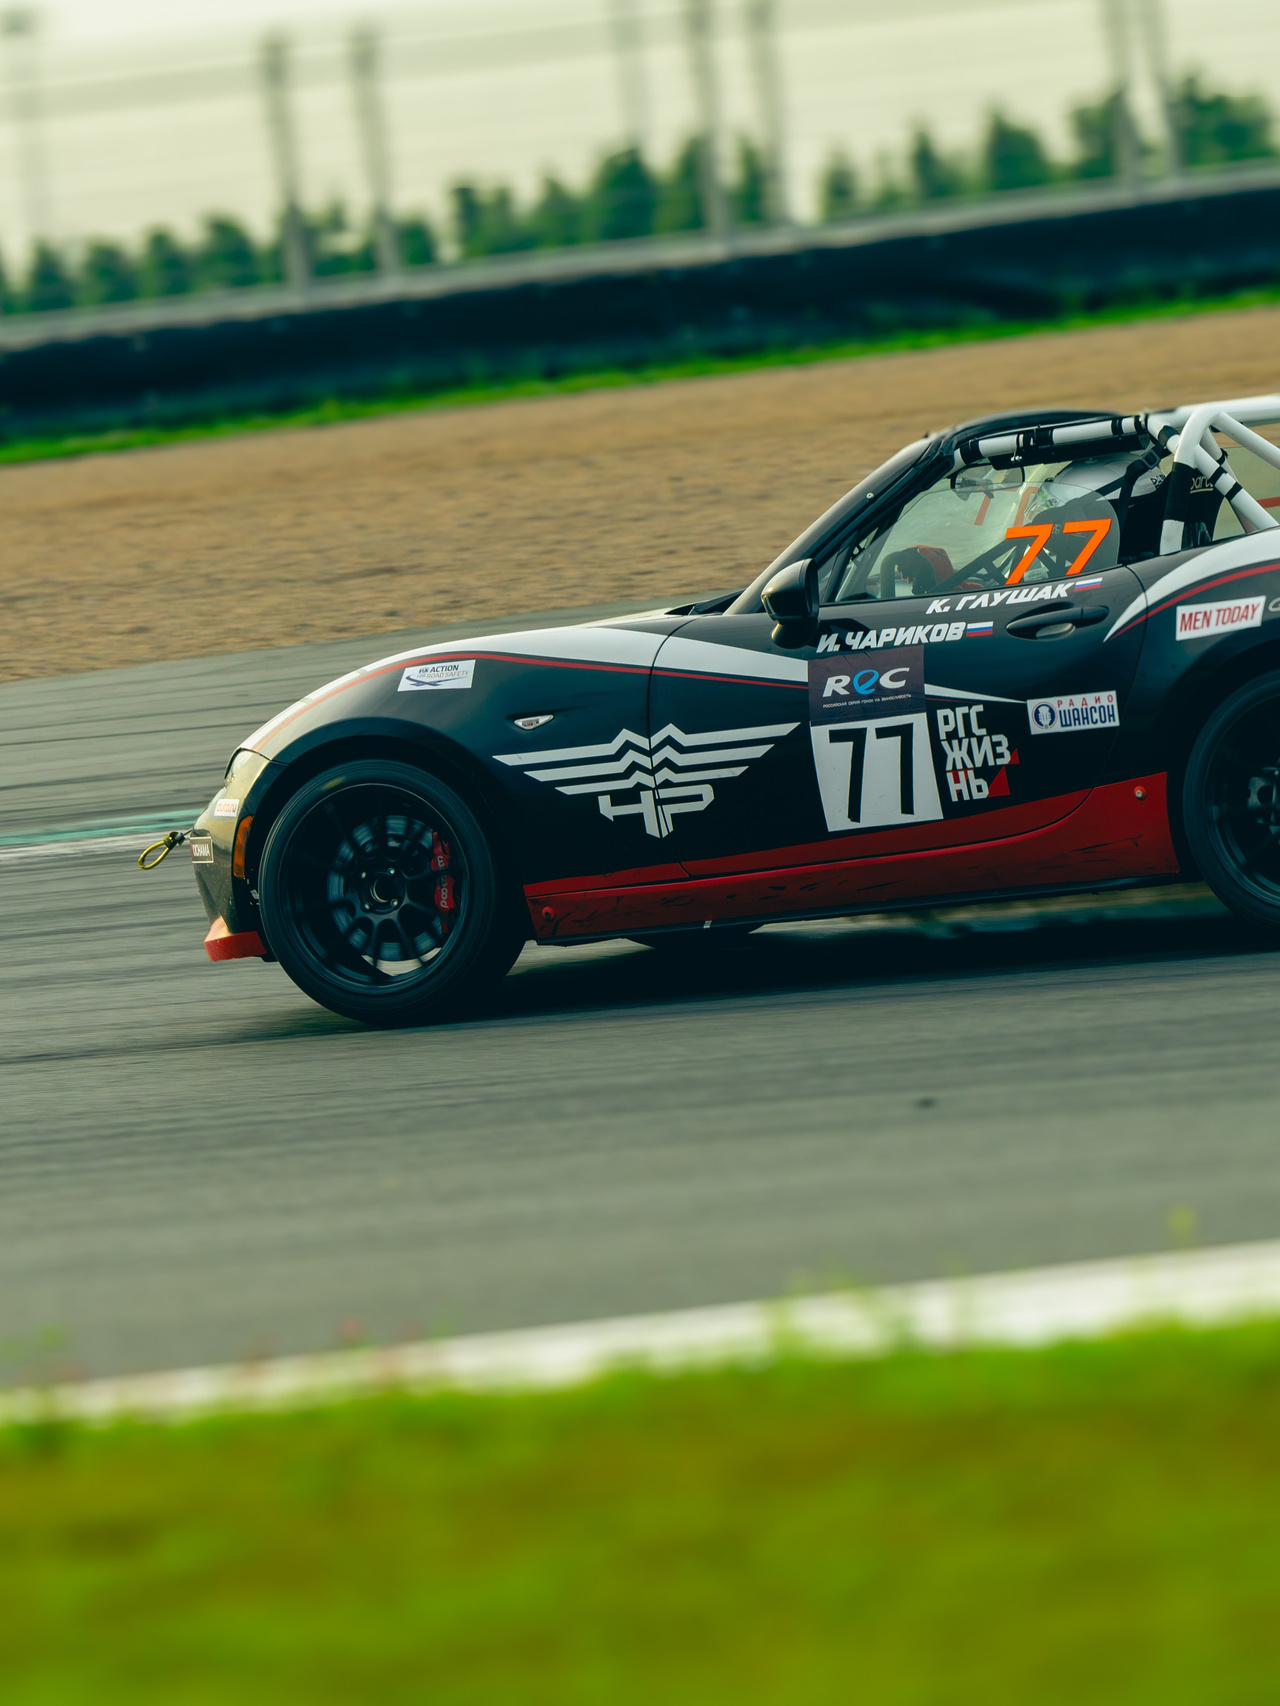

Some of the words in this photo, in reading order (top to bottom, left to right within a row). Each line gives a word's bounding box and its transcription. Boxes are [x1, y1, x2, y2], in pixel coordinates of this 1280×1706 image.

[1005, 518, 1112, 585] 77
[955, 583, 1075, 611] ГЛУШАК
[1179, 609, 1211, 632] MEN
[1214, 603, 1260, 627] TODAY
[845, 621, 967, 649] ЧАРИКОВ
[430, 664, 460, 673] ACTION
[445, 670, 469, 678] SAFETY
[1057, 694, 1114, 708] РАДИО
[937, 704, 988, 740] РГС
[1059, 704, 1116, 728] ШАНСОН
[941, 734, 1011, 771] ЖИЗ
[829, 722, 914, 823] 77
[945, 769, 989, 801] НЬ
